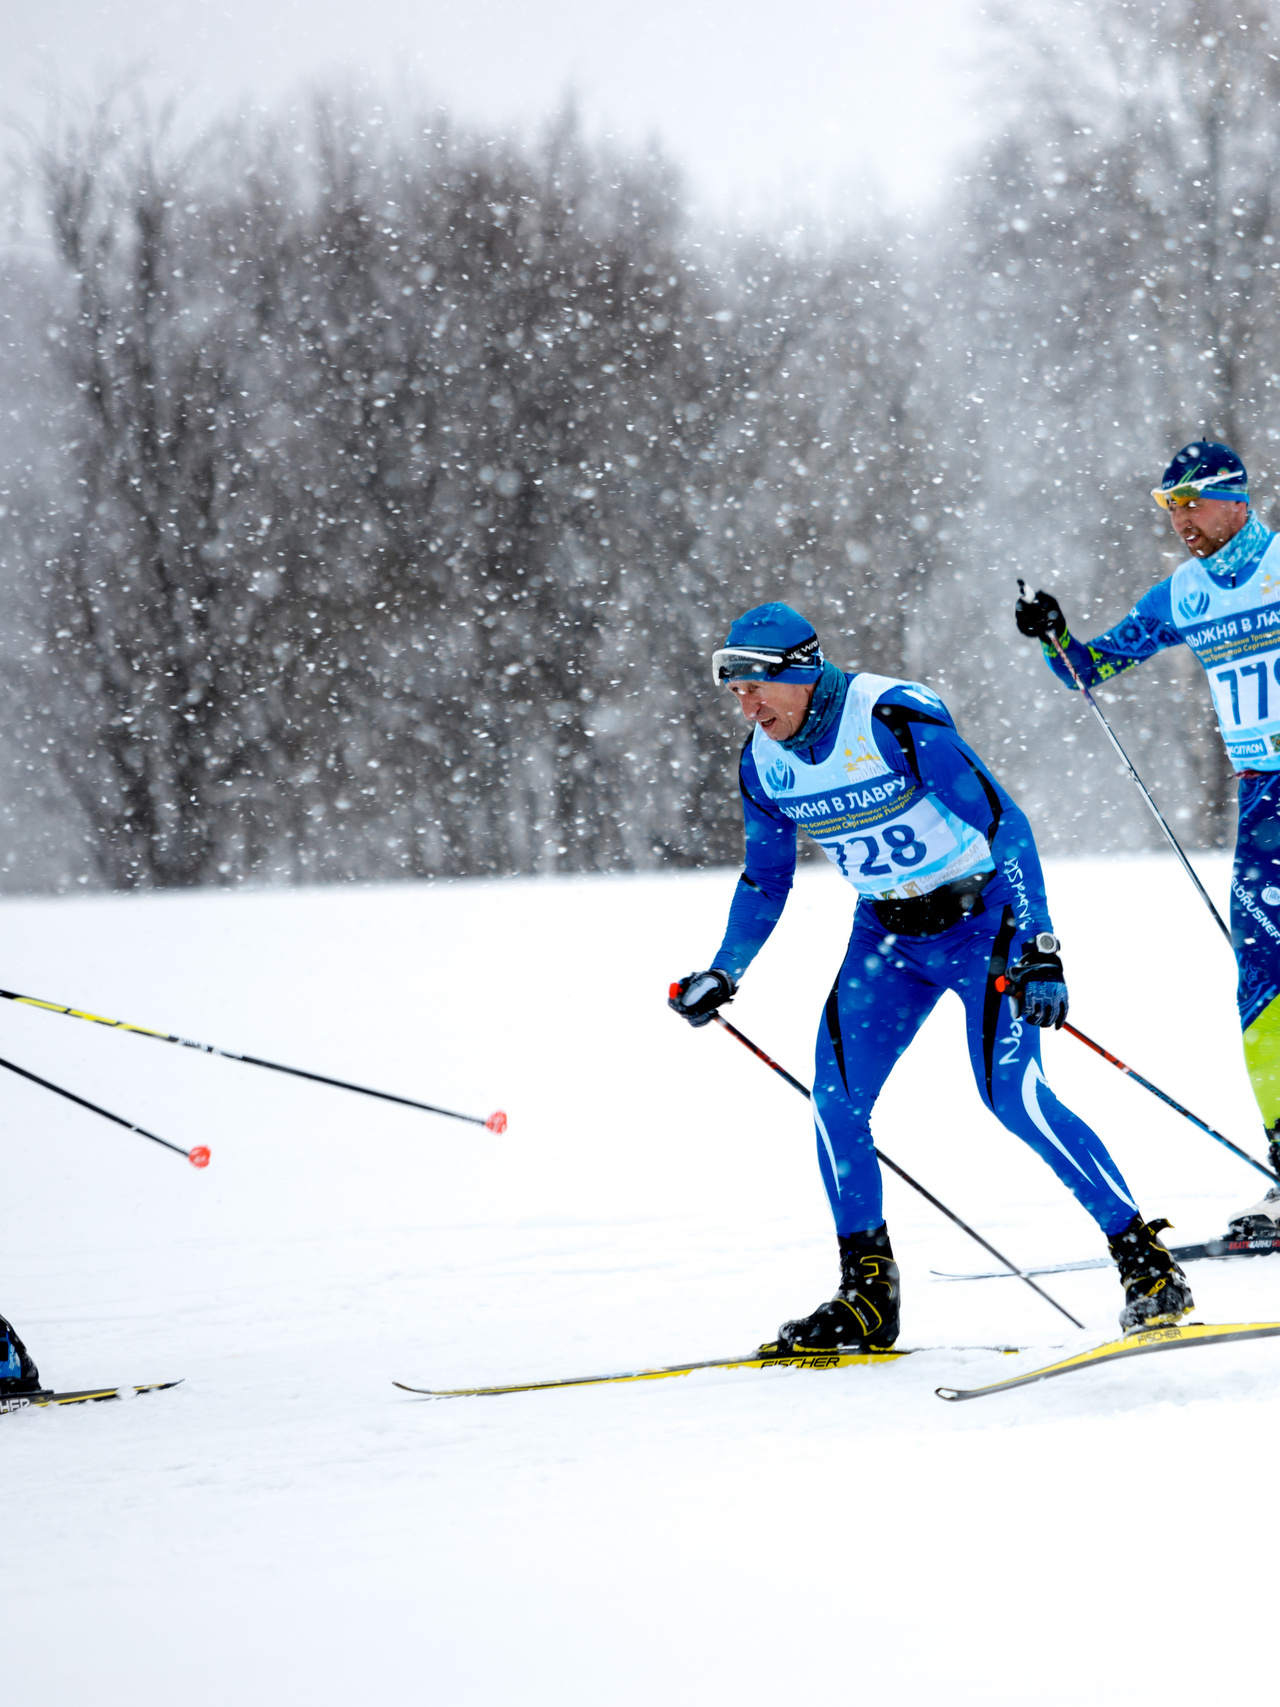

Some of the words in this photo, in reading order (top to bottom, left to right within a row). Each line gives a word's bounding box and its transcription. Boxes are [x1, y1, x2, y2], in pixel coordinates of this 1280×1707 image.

[1241, 618, 1252, 632] В
[780, 800, 831, 819] ЫЖНЯ
[831, 797, 845, 812] В
[845, 776, 906, 809] ЛАВРУ
[1137, 1328, 1182, 1346] FISCHER
